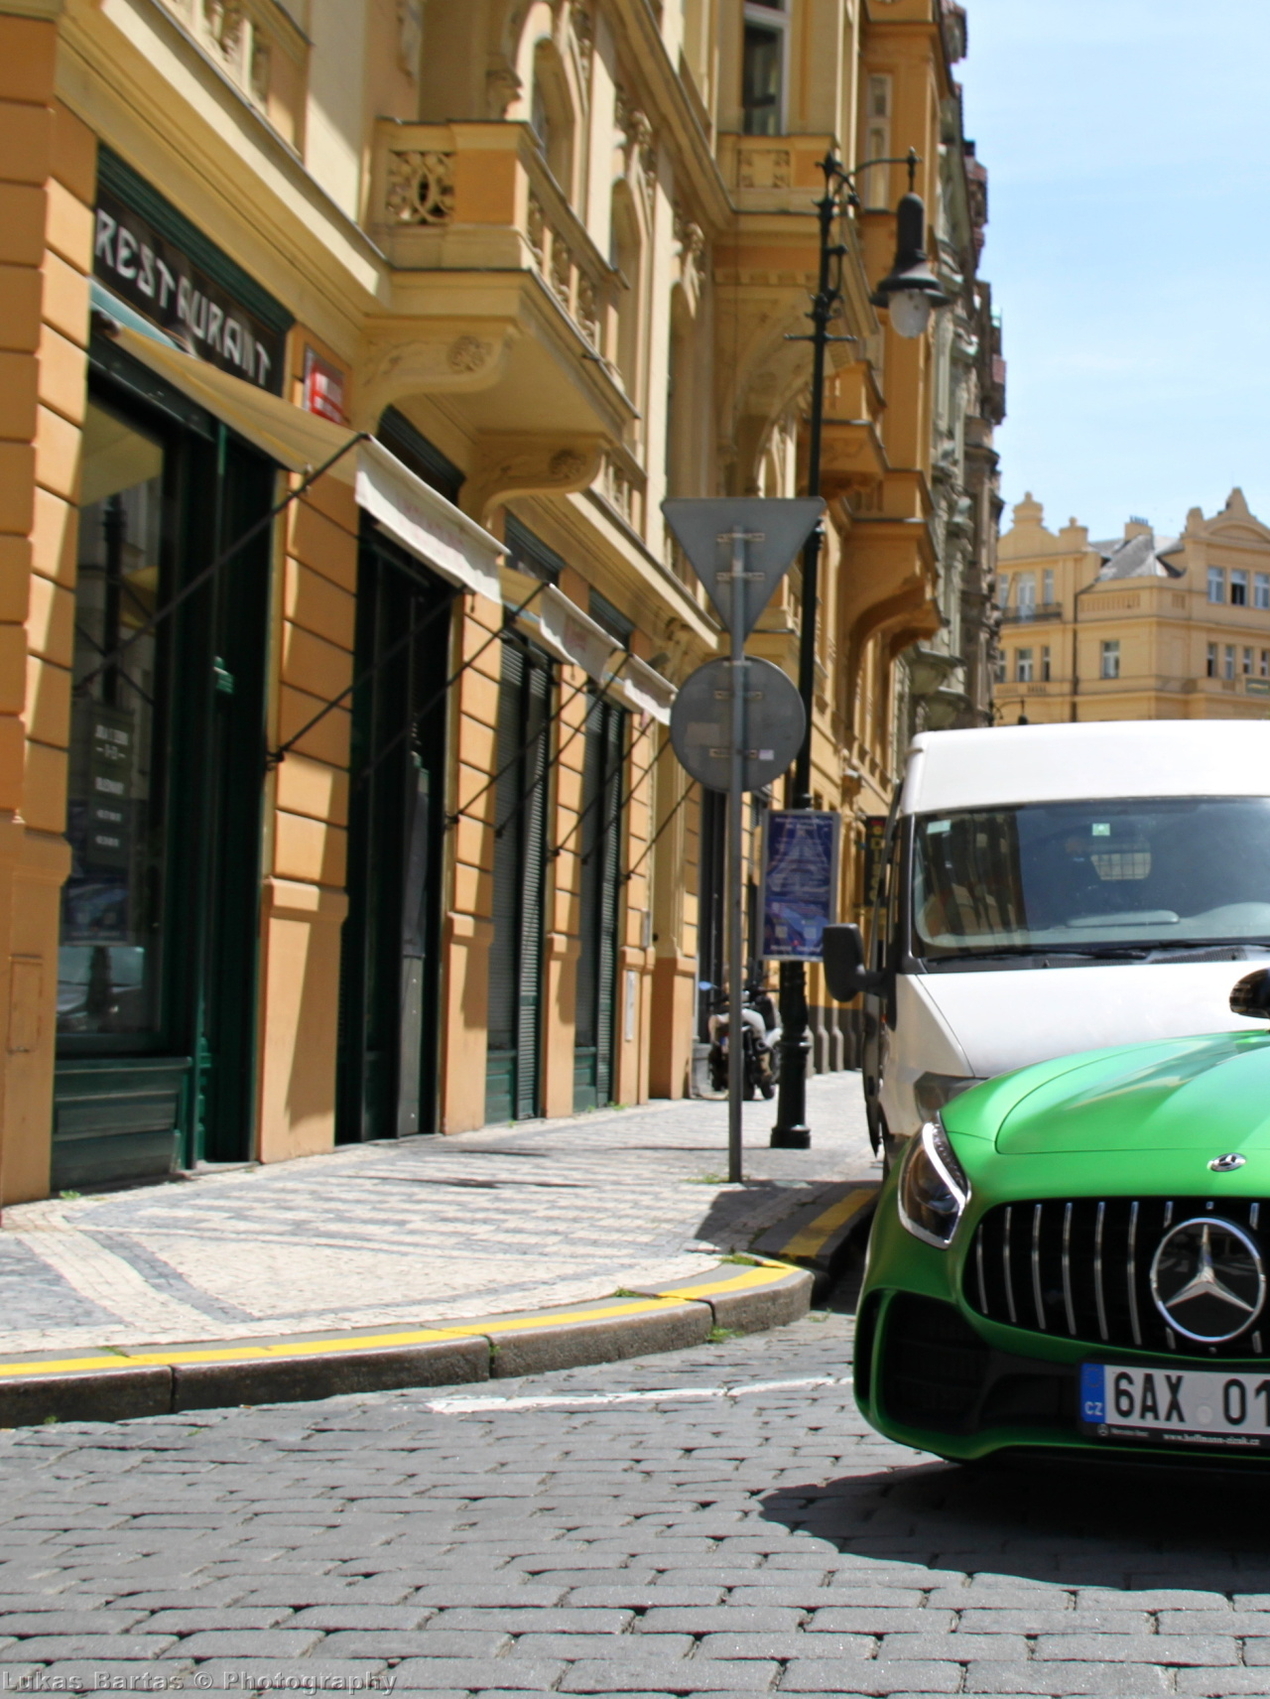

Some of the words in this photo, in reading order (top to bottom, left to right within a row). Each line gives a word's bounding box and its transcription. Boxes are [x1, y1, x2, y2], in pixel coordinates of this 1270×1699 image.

[96, 207, 271, 386] RESTAURANT
[1084, 1401, 1104, 1416] CZ
[1113, 1371, 1186, 1424] 6AX
